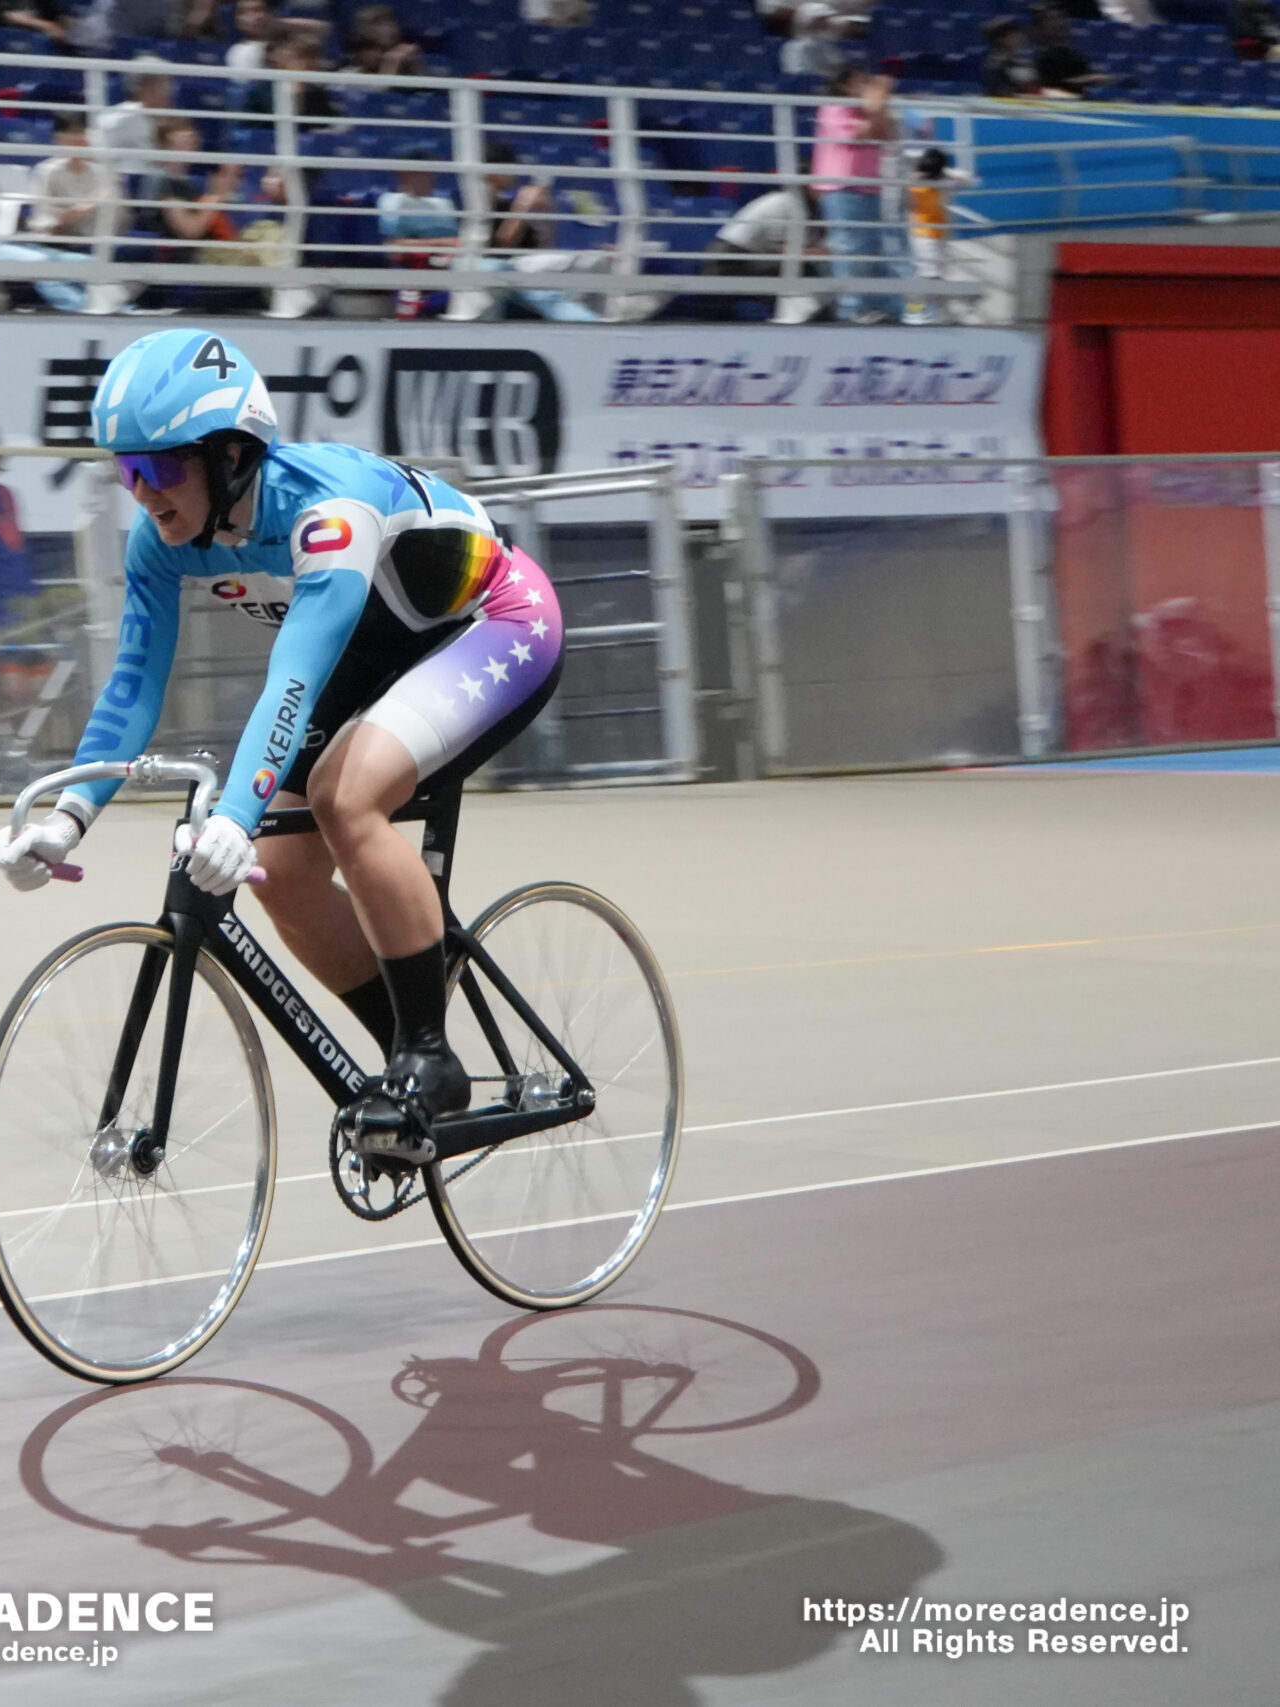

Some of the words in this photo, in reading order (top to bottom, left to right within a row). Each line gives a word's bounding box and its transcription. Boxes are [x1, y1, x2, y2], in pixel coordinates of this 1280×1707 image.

[192, 337, 237, 380] 4
[396, 370, 540, 477] WEB
[263, 678, 305, 770] KEIRIN
[218, 911, 366, 1093] BRIDGESTONE
